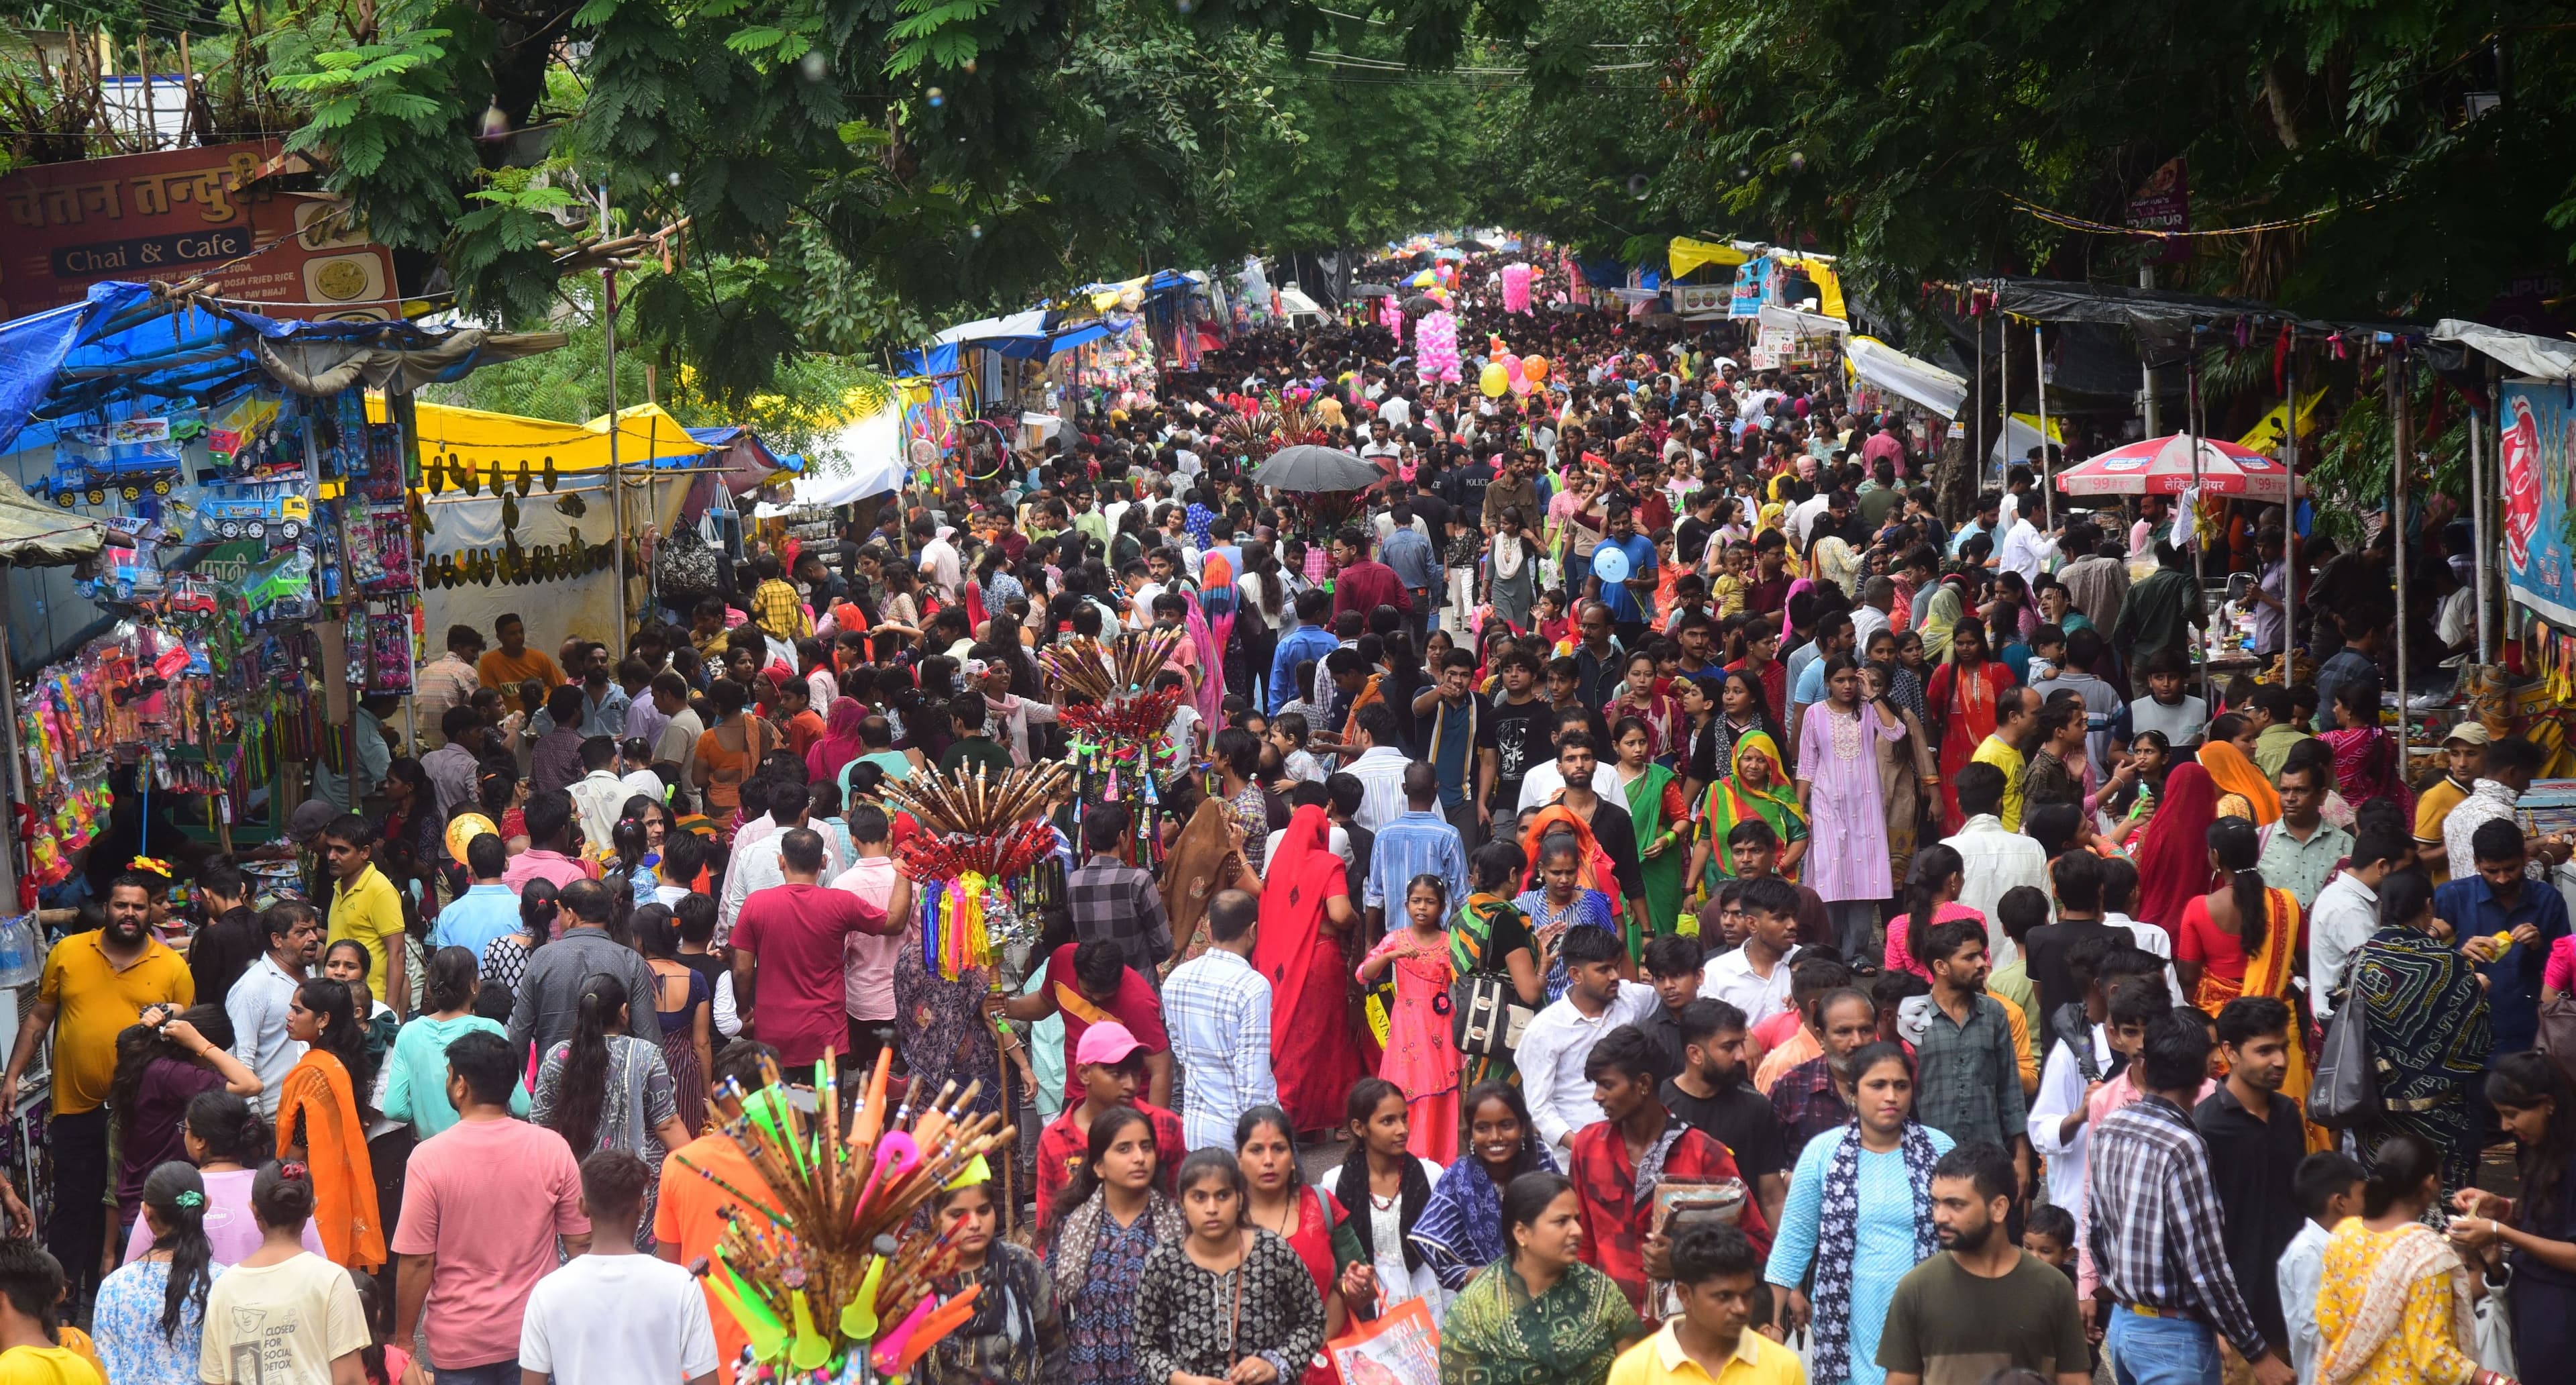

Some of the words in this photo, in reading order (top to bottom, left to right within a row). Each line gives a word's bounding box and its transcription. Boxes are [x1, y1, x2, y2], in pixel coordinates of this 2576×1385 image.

[5, 176, 121, 228] चेतन
[67, 246, 127, 271] Chai
[141, 244, 162, 263] &
[177, 234, 236, 258] Cafe
[229, 262, 253, 274] SODA,
[224, 276, 246, 288] DOSA
[247, 272, 272, 285] FRIED
[274, 270, 296, 282] RICE,
[246, 289, 260, 300] PAV
[262, 287, 287, 297] BHAJI
[1782, 343, 1794, 353] 60
[1753, 354, 1763, 368] 60
[1466, 478, 1489, 486] POLICE
[2199, 477, 2226, 491] वियर
[108, 518, 137, 529] HAR
[266, 1325, 295, 1337] CLOSED
[264, 1337, 282, 1349] FOR
[264, 1347, 292, 1361] SOCIAL
[264, 1360, 291, 1372] DETOX
